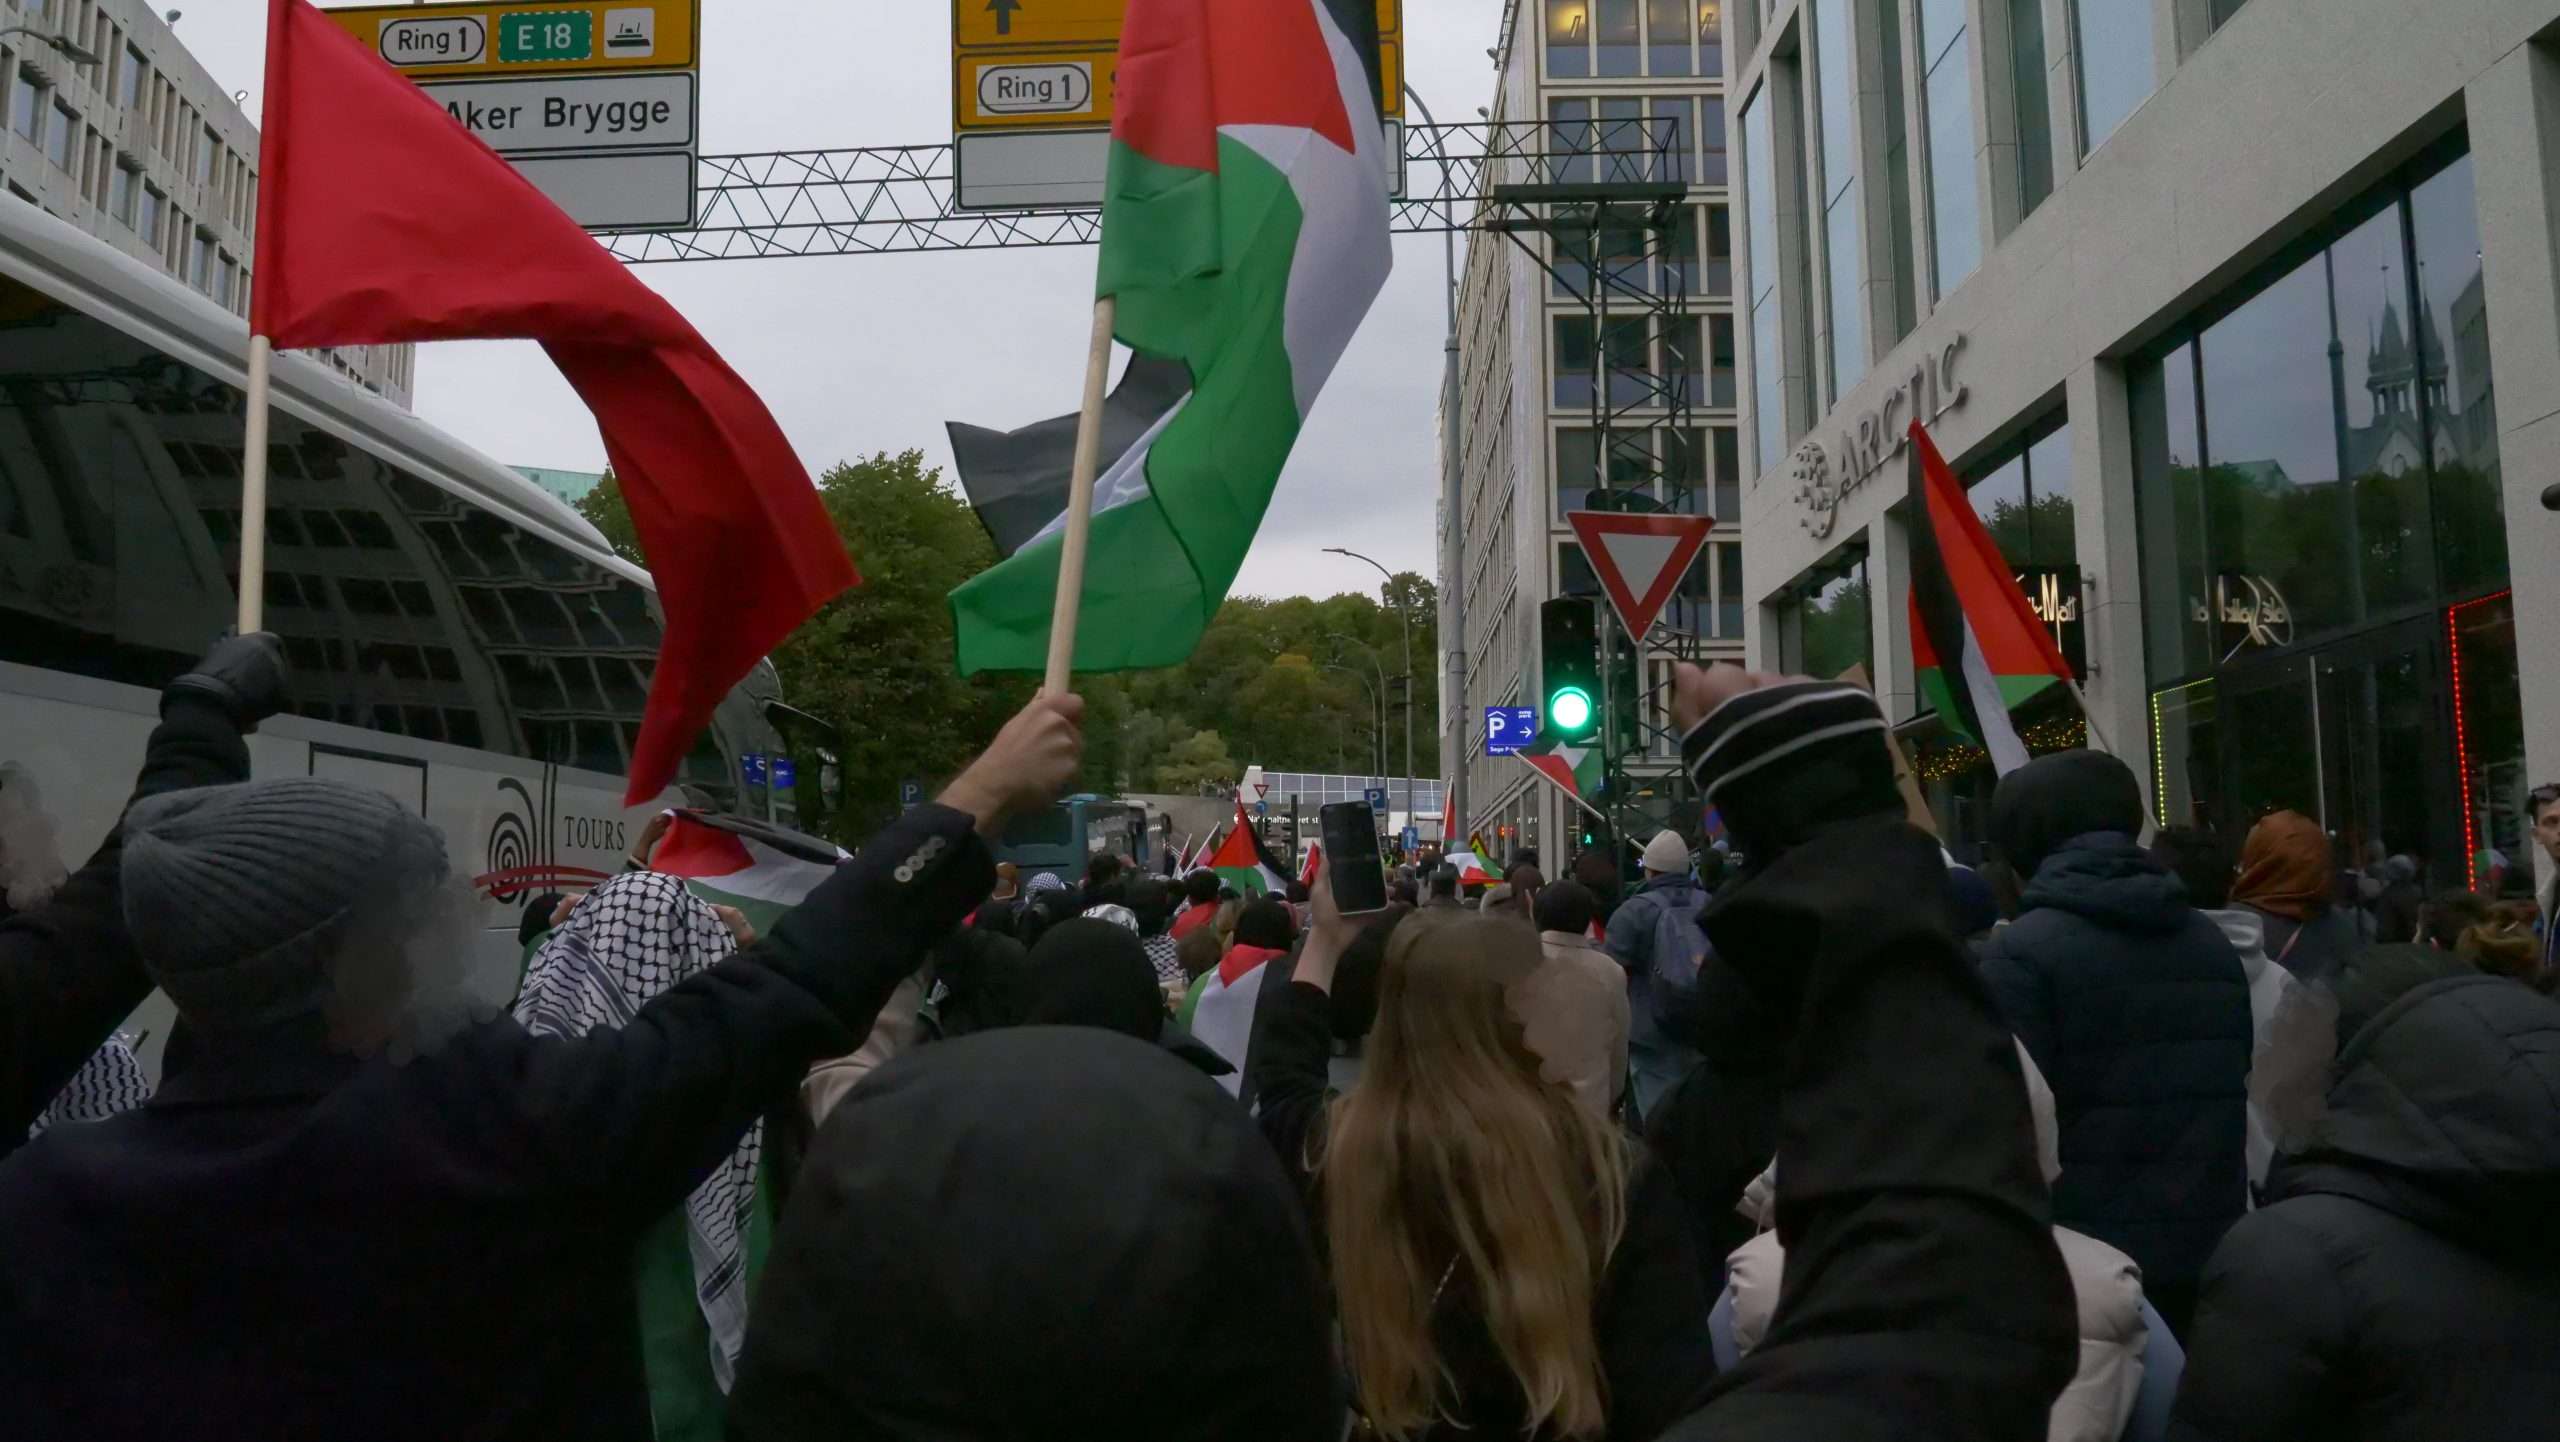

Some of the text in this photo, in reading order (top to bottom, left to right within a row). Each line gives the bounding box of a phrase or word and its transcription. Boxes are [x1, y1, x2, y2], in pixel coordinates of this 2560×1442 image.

[399, 27, 467, 54] Ring 1
[518, 24, 573, 50] E 18
[998, 74, 1070, 103] Ring 1
[544, 97, 671, 134] Brygge
[1840, 330, 1970, 502] ARCTIC
[1489, 717, 1505, 739] P
[564, 815, 626, 851] TOURS
